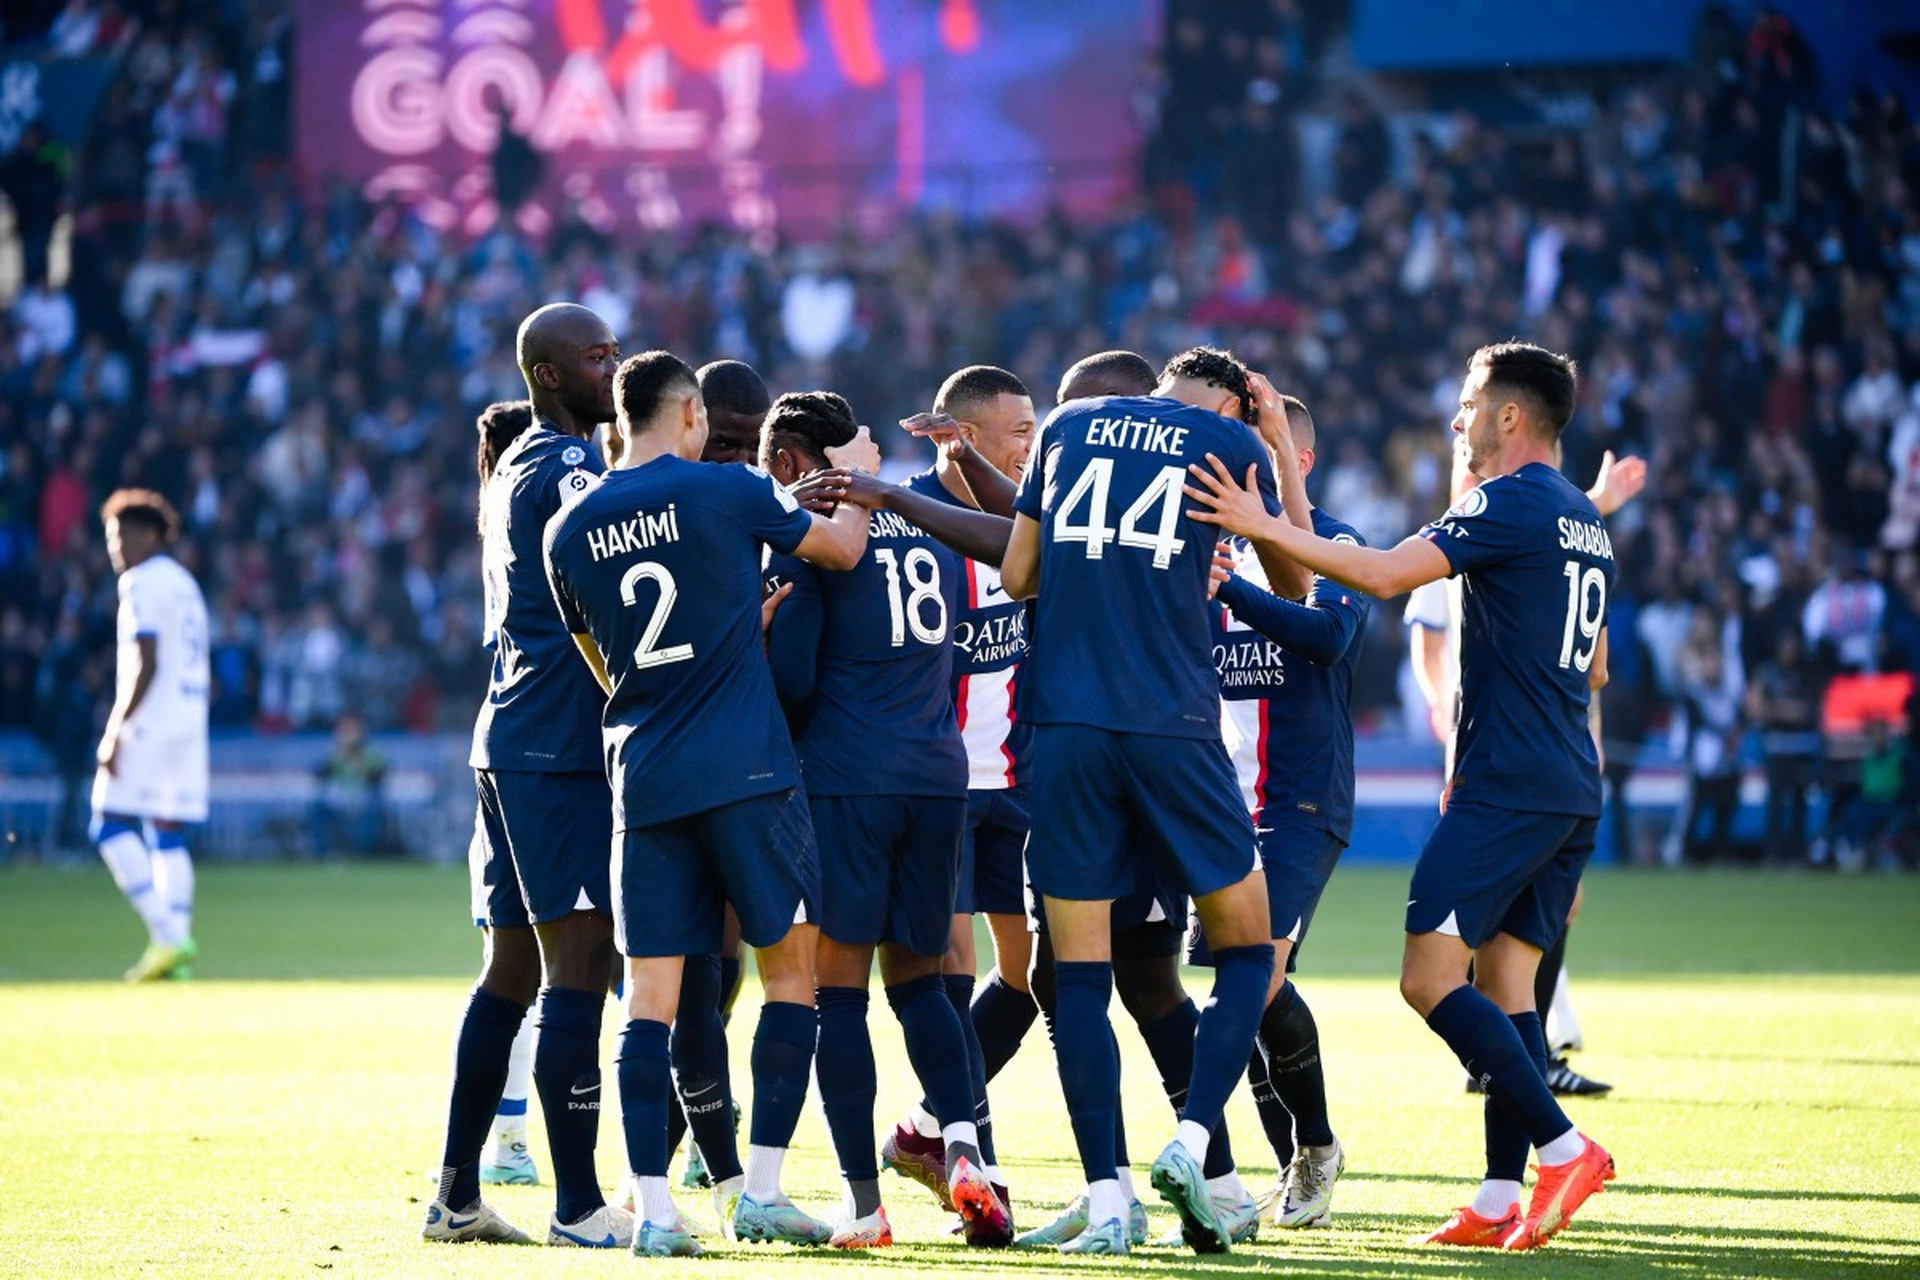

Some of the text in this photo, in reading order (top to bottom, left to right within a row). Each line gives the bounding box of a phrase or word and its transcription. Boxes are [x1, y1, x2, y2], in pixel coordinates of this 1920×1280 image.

[1053, 457, 1187, 570] 44
[620, 561, 694, 669] 2
[874, 547, 947, 647] 18
[1558, 560, 1606, 672] 19
[1211, 641, 1284, 675] QATAR
[1222, 668, 1285, 688] AIRWAYS
[684, 1098, 724, 1114] PARIS
